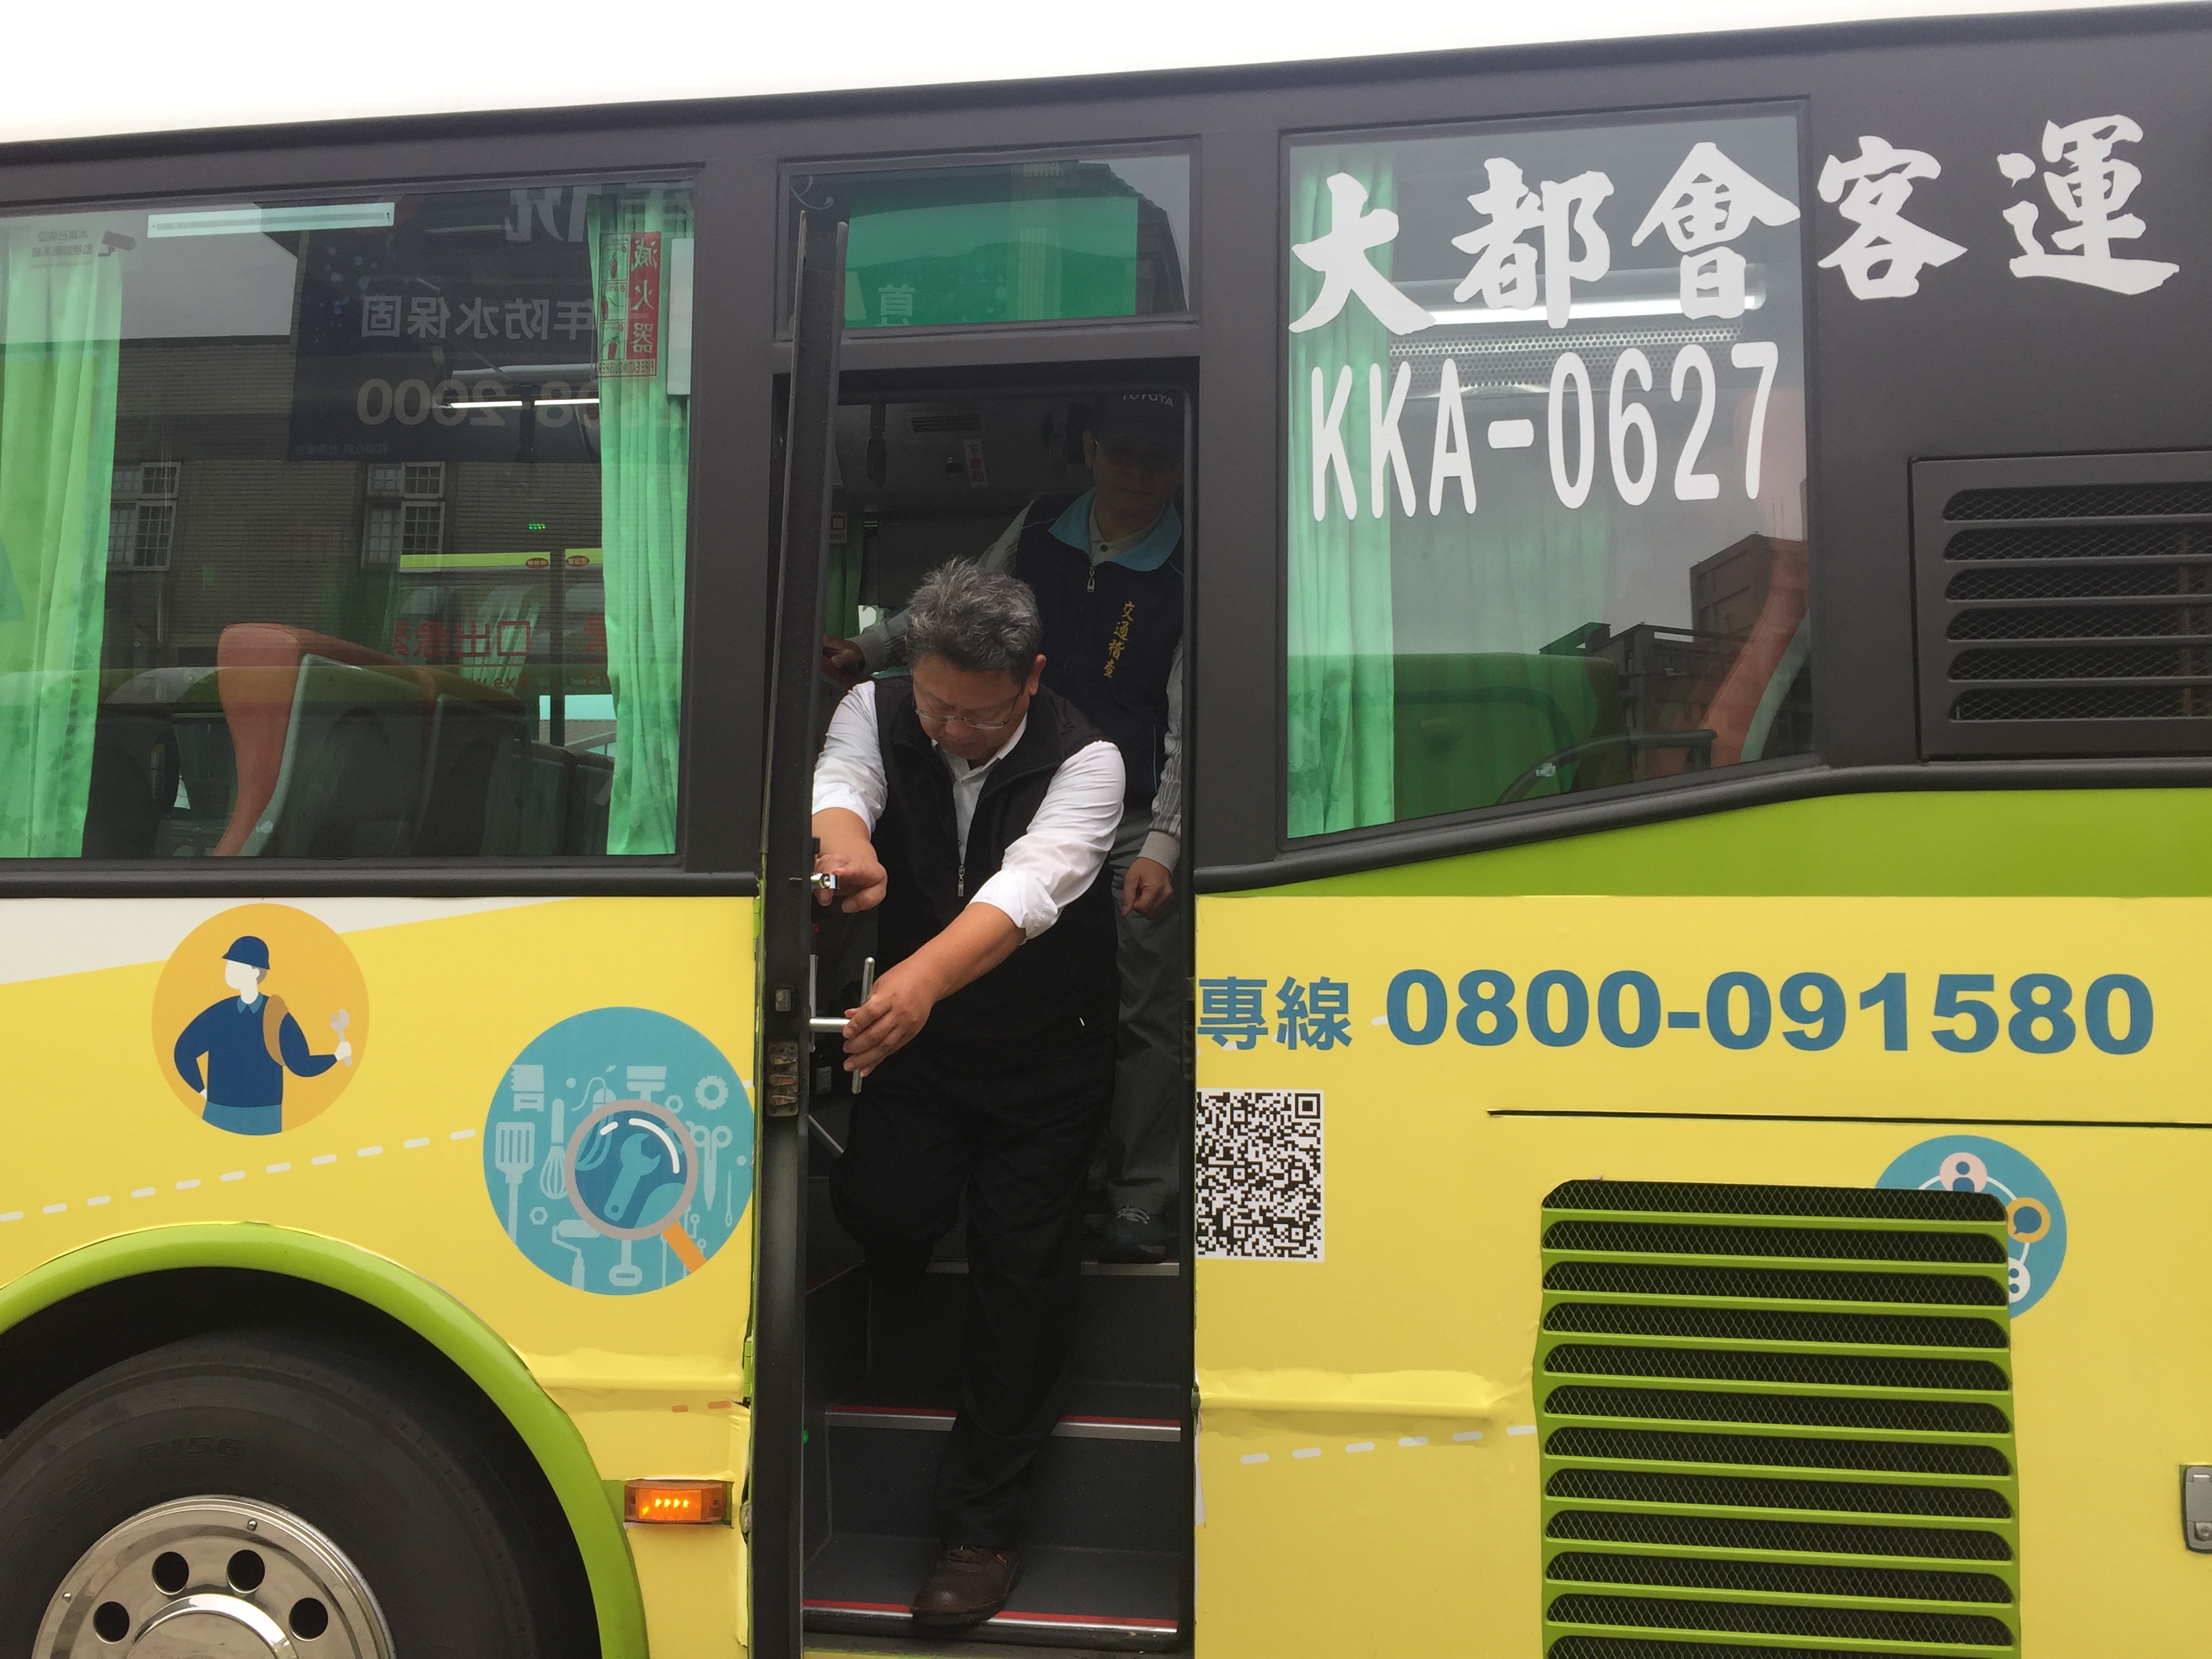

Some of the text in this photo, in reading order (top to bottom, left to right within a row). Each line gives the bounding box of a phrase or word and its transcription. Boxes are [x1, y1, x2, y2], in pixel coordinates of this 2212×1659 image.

[1288, 114, 2180, 335] 大都會客運
[1310, 341, 1779, 522] KKA-0627
[1103, 600, 1136, 678] 交通稽查
[1197, 976, 1353, 1052] 專線
[1386, 968, 2154, 1056] 0800-091580
